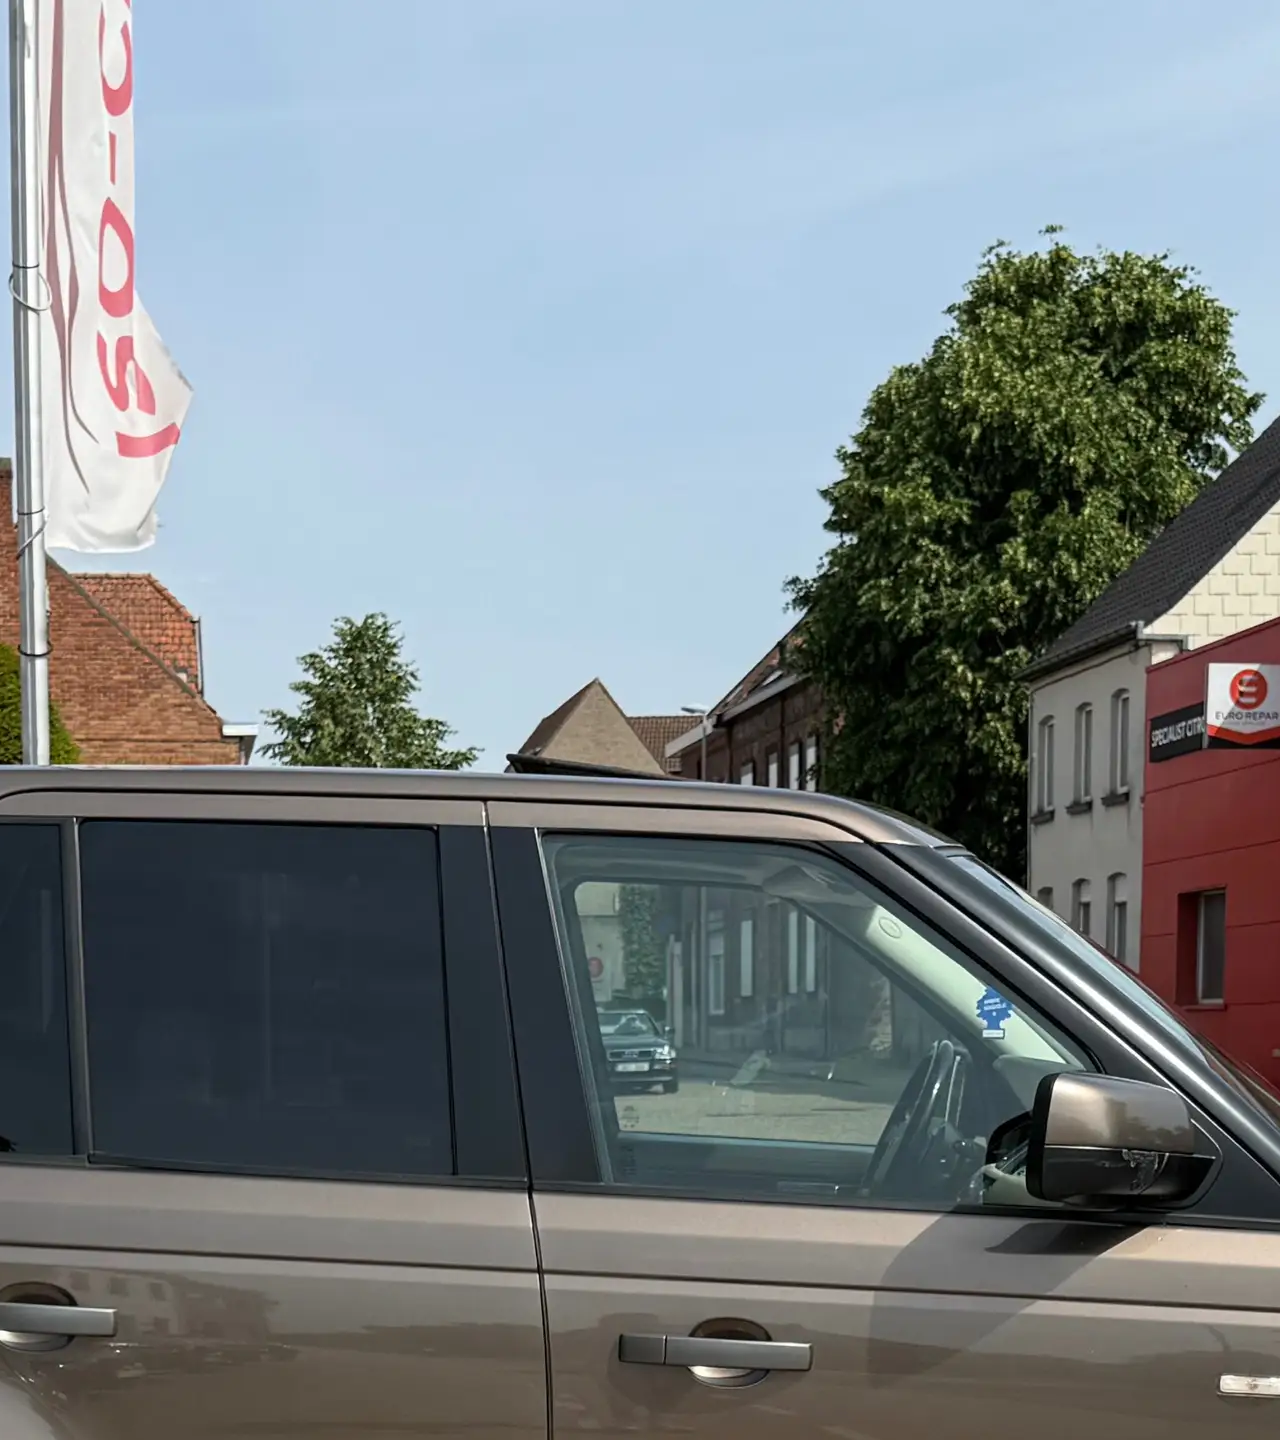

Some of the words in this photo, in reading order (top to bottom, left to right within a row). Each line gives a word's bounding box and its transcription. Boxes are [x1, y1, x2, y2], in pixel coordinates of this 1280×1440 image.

[1214, 711, 1244, 722] EURO
[1245, 710, 1280, 722] REPAR
[1151, 720, 1186, 748] SPECIALIST
